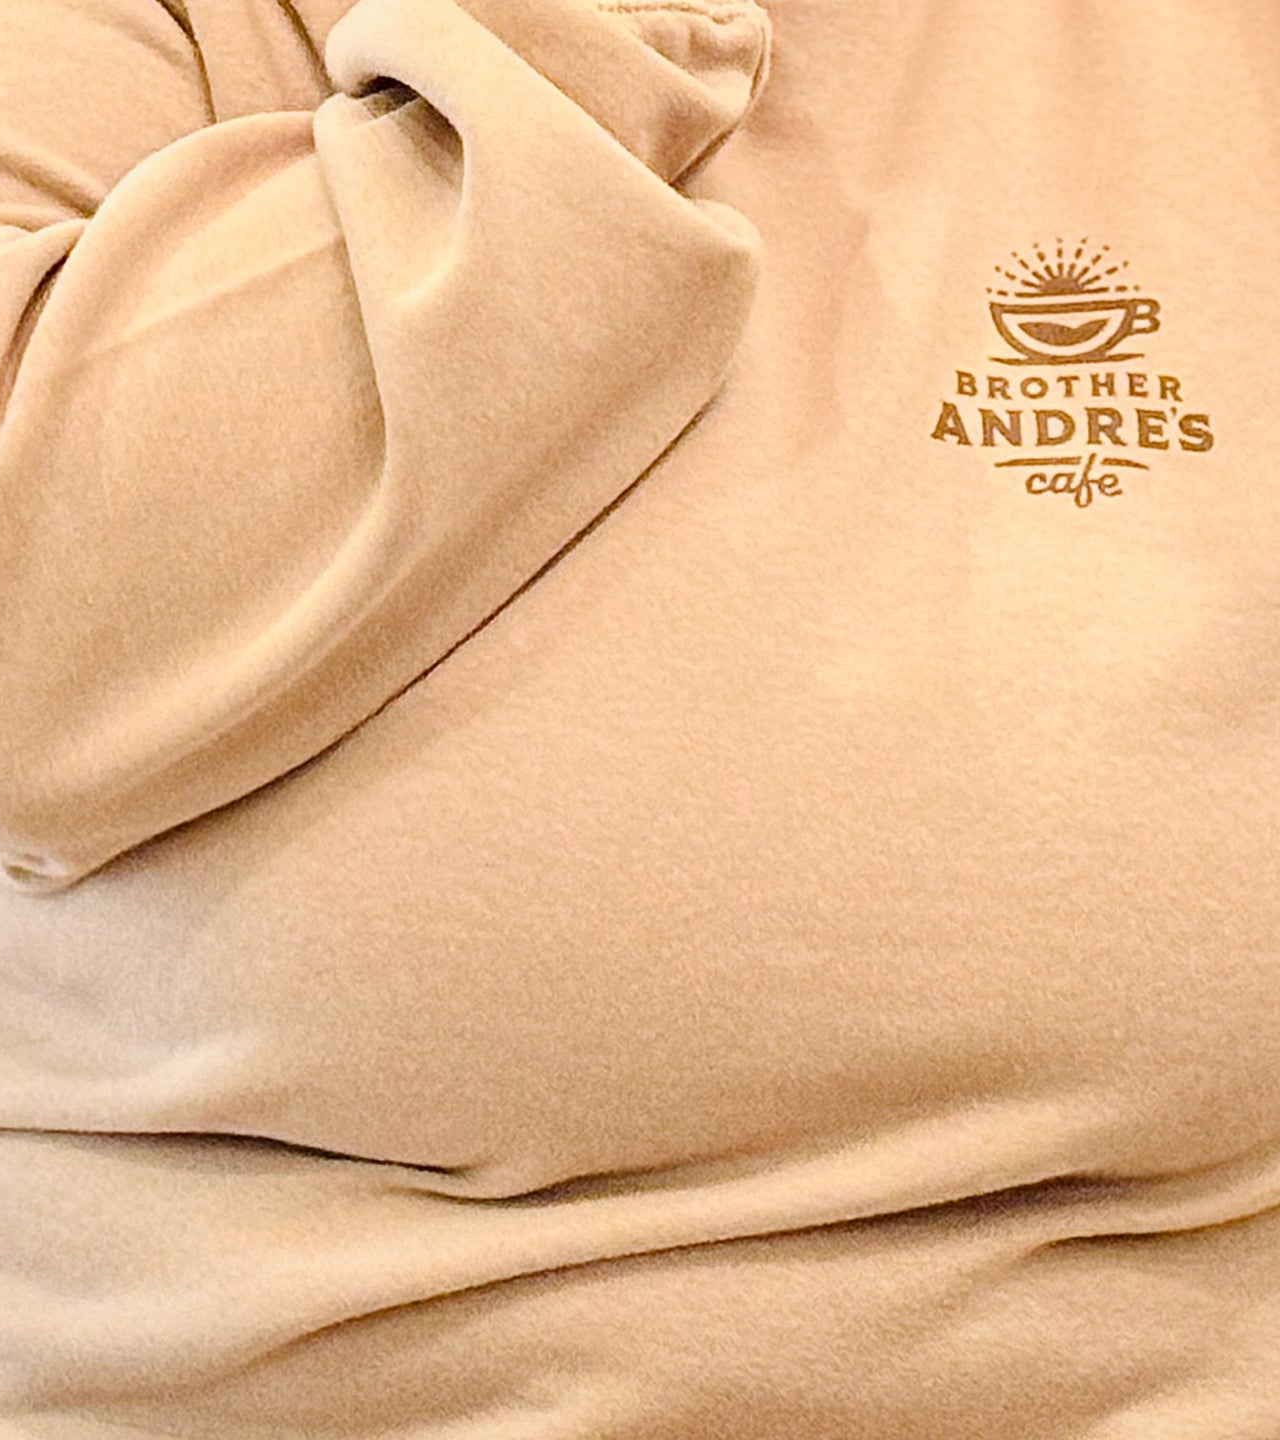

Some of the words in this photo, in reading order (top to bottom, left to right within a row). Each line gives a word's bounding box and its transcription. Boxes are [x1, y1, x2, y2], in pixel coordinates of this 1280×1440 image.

[955, 369, 1183, 403] BROTHER
[930, 401, 1215, 453] ANDRE'S
[1025, 453, 1124, 508] cafe
